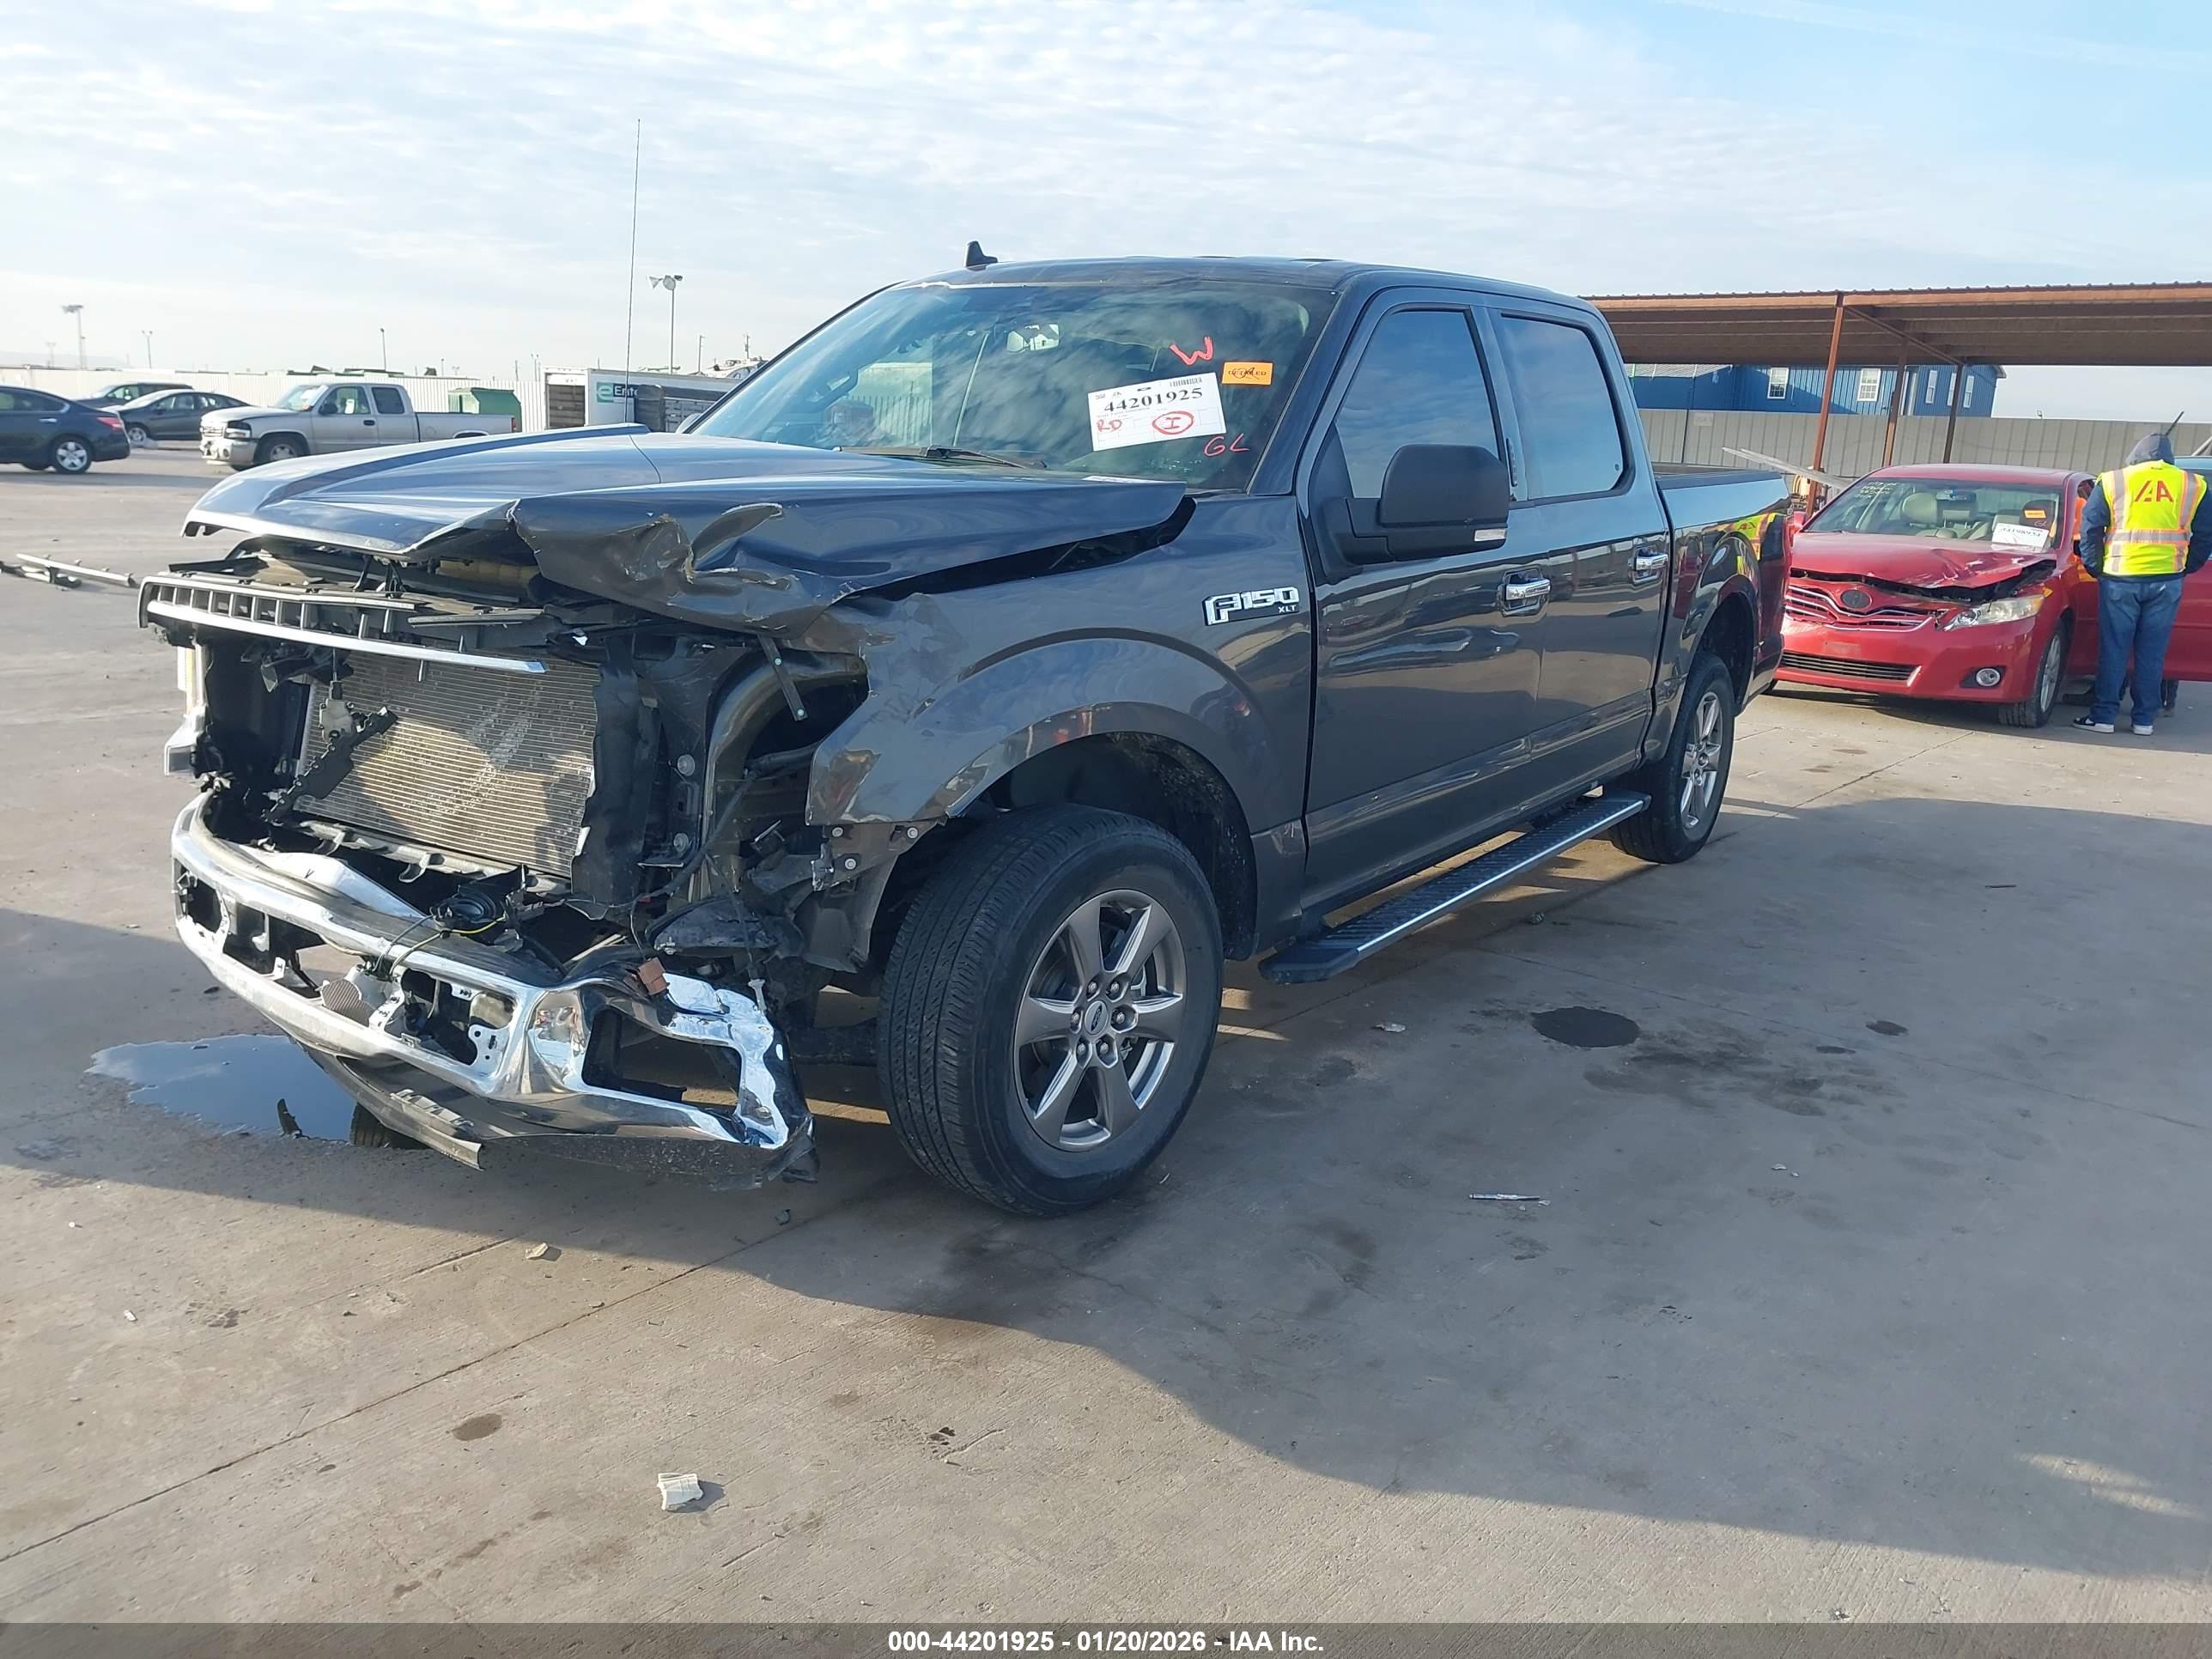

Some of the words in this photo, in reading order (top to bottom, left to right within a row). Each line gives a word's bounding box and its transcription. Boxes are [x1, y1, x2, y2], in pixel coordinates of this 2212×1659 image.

[1170, 336, 1213, 366] W
[1104, 387, 1203, 412] 44201925
[1278, 605, 1297, 613] XLT
